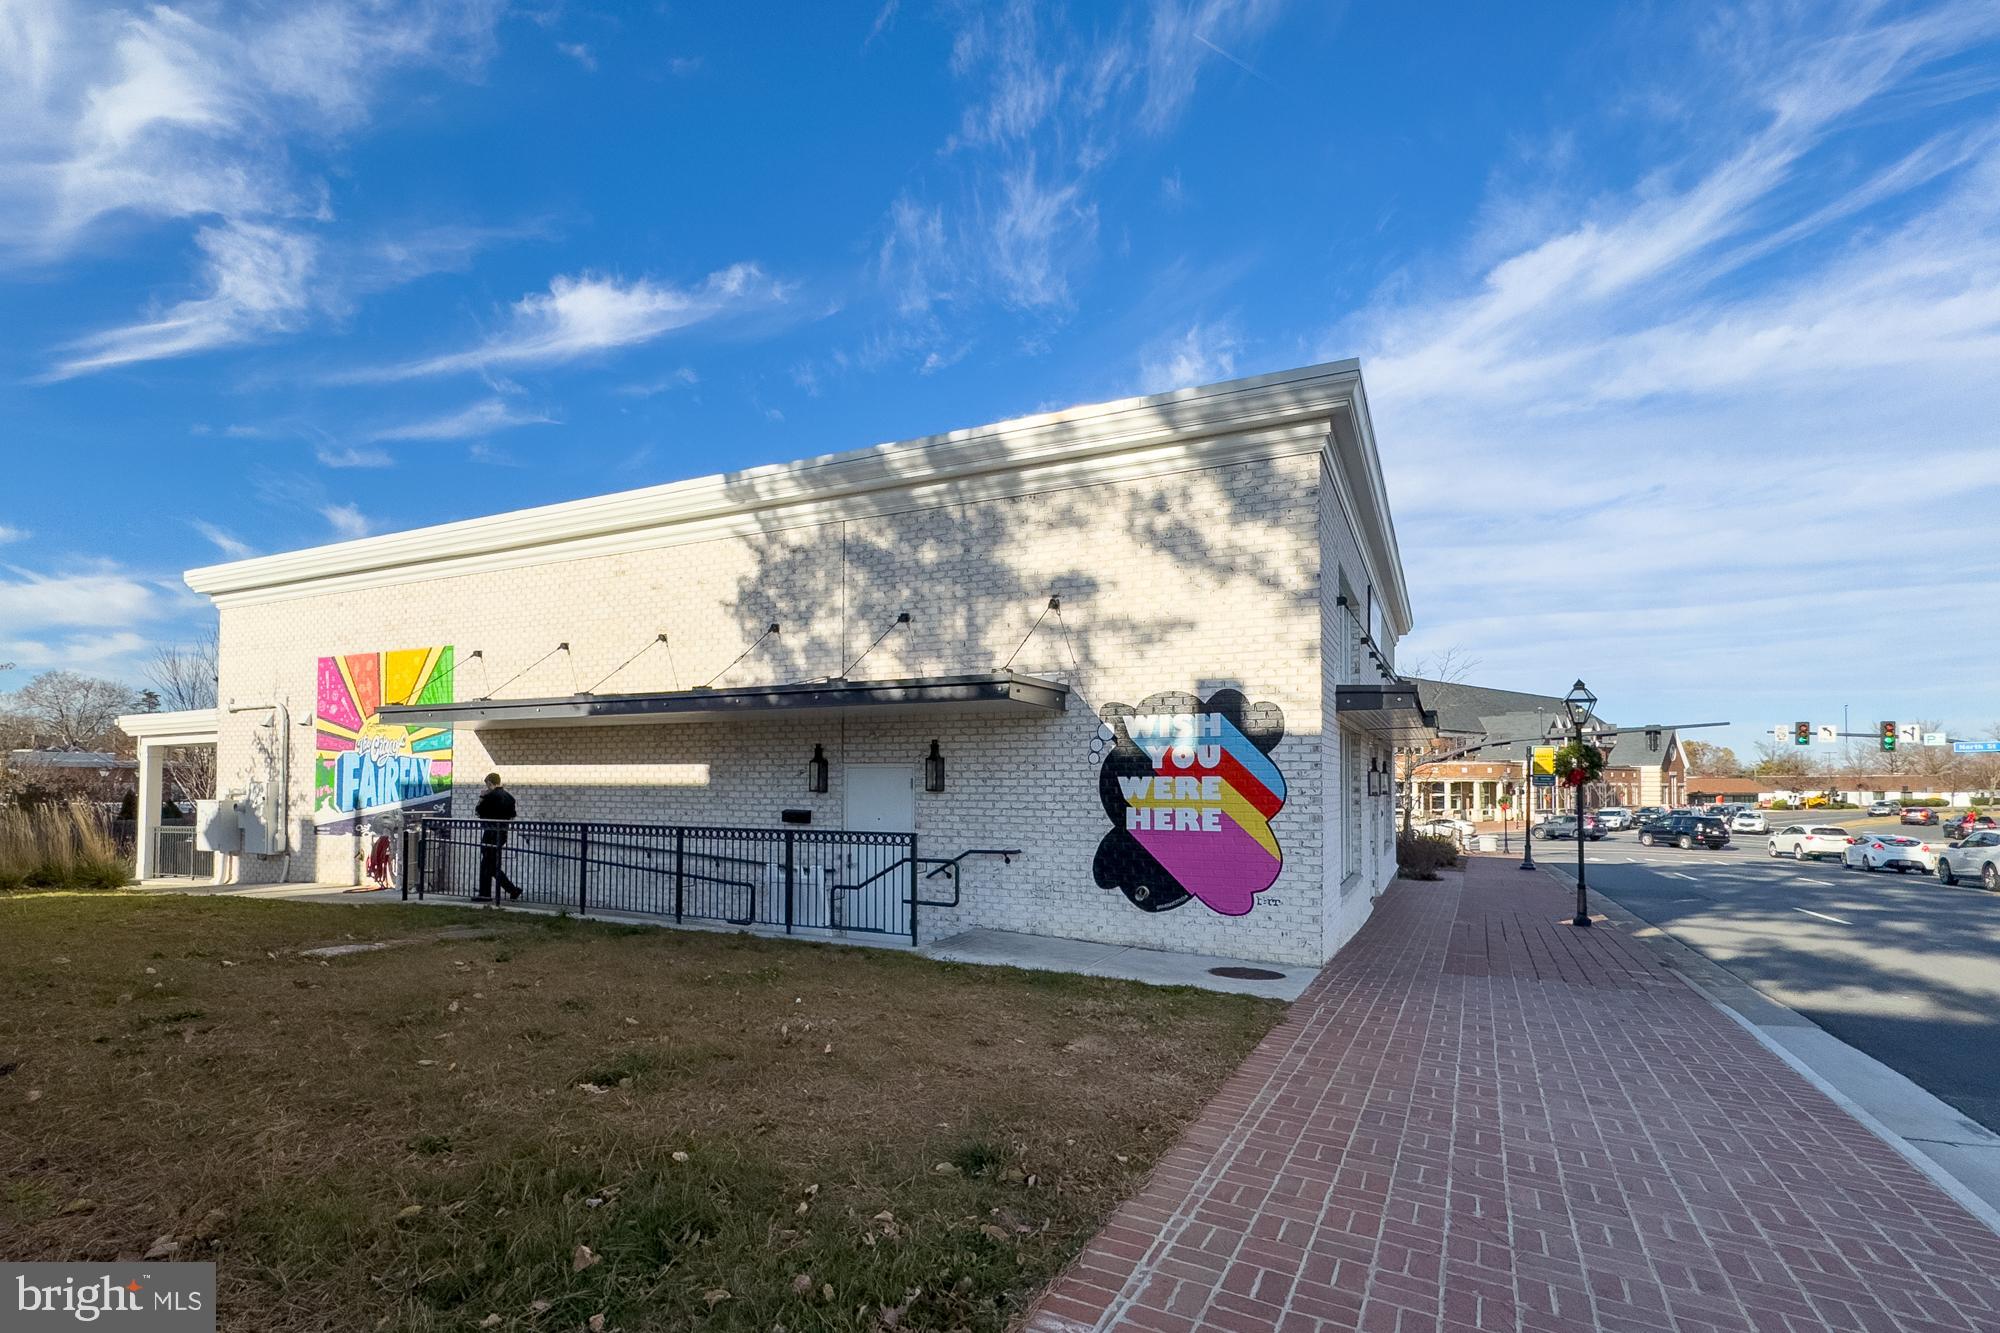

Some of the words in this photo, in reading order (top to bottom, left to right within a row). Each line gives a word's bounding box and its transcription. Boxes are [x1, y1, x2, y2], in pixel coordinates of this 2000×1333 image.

[1123, 713, 1221, 738] WISH
[1145, 744, 1221, 769] YOU
[1117, 776, 1221, 800] WERE
[1126, 807, 1222, 831] HERE
